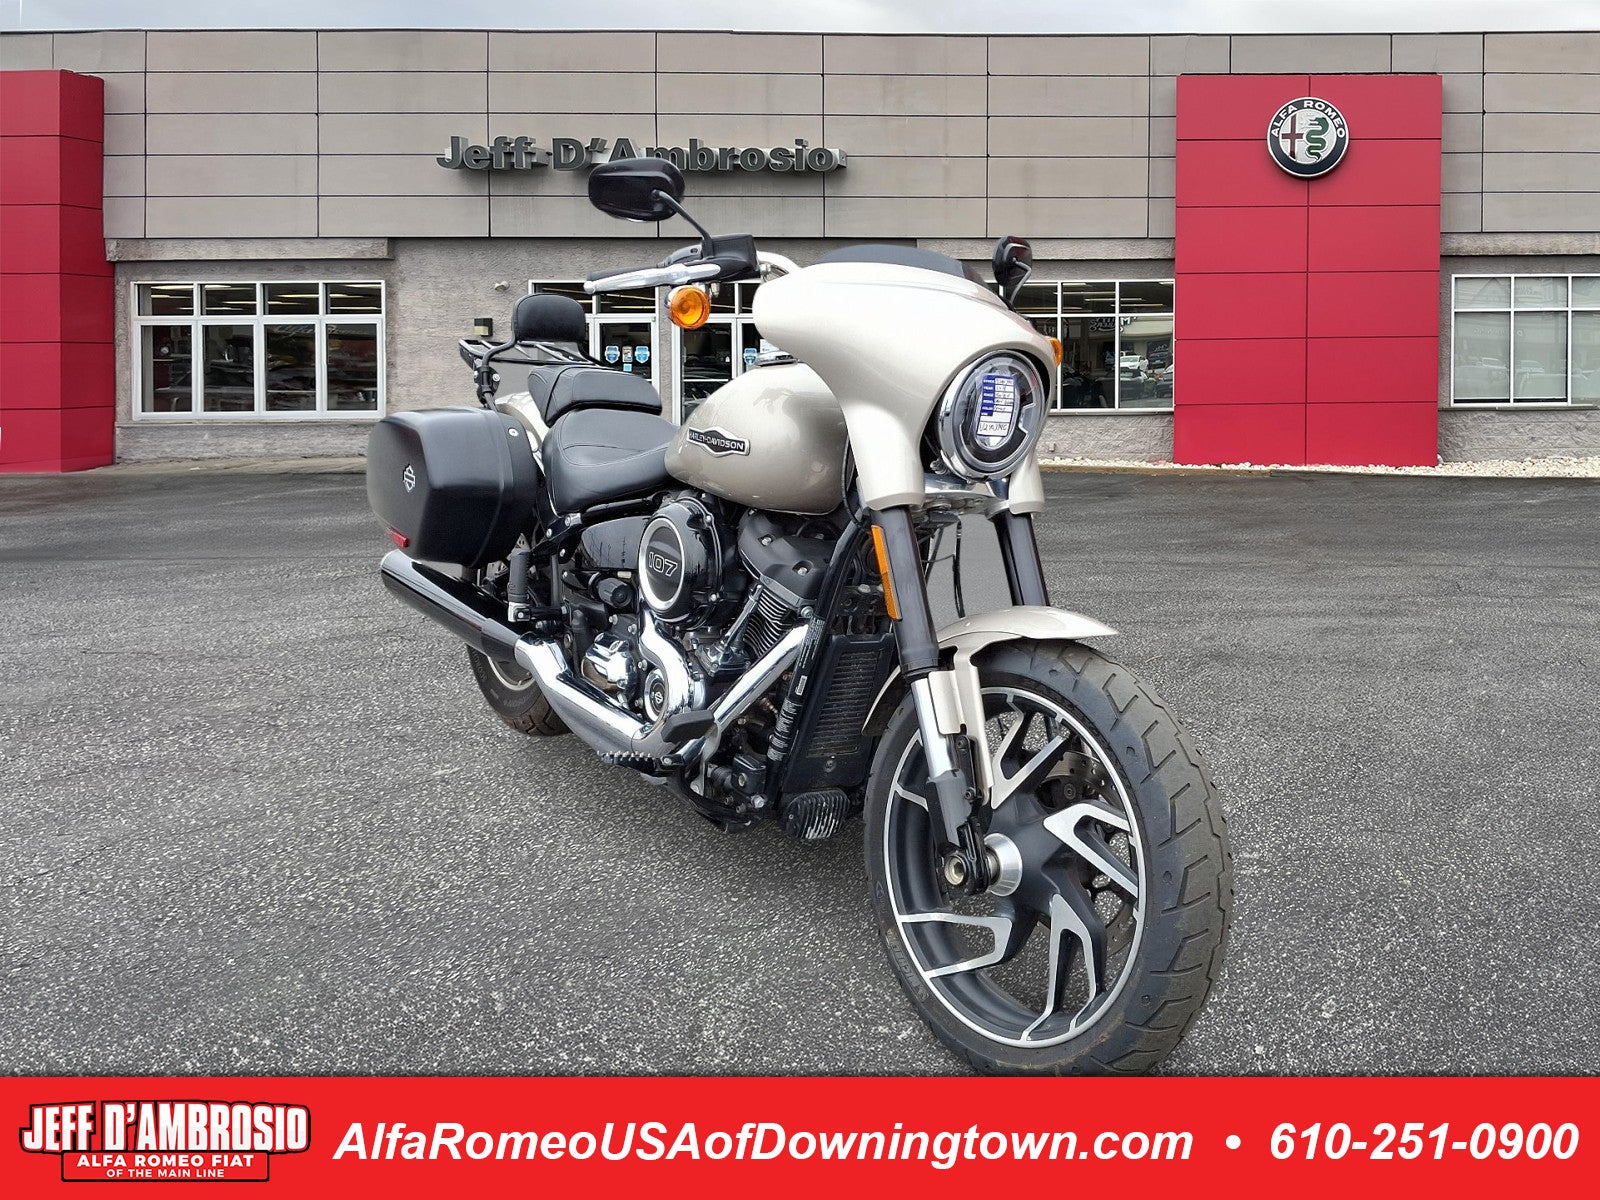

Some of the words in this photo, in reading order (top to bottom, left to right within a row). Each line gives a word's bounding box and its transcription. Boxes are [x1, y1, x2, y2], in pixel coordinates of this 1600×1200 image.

[1271, 105, 1298, 138] ALFA
[1303, 100, 1346, 138] ROMEO
[437, 135, 533, 170] Jeff
[648, 551, 678, 577] 107
